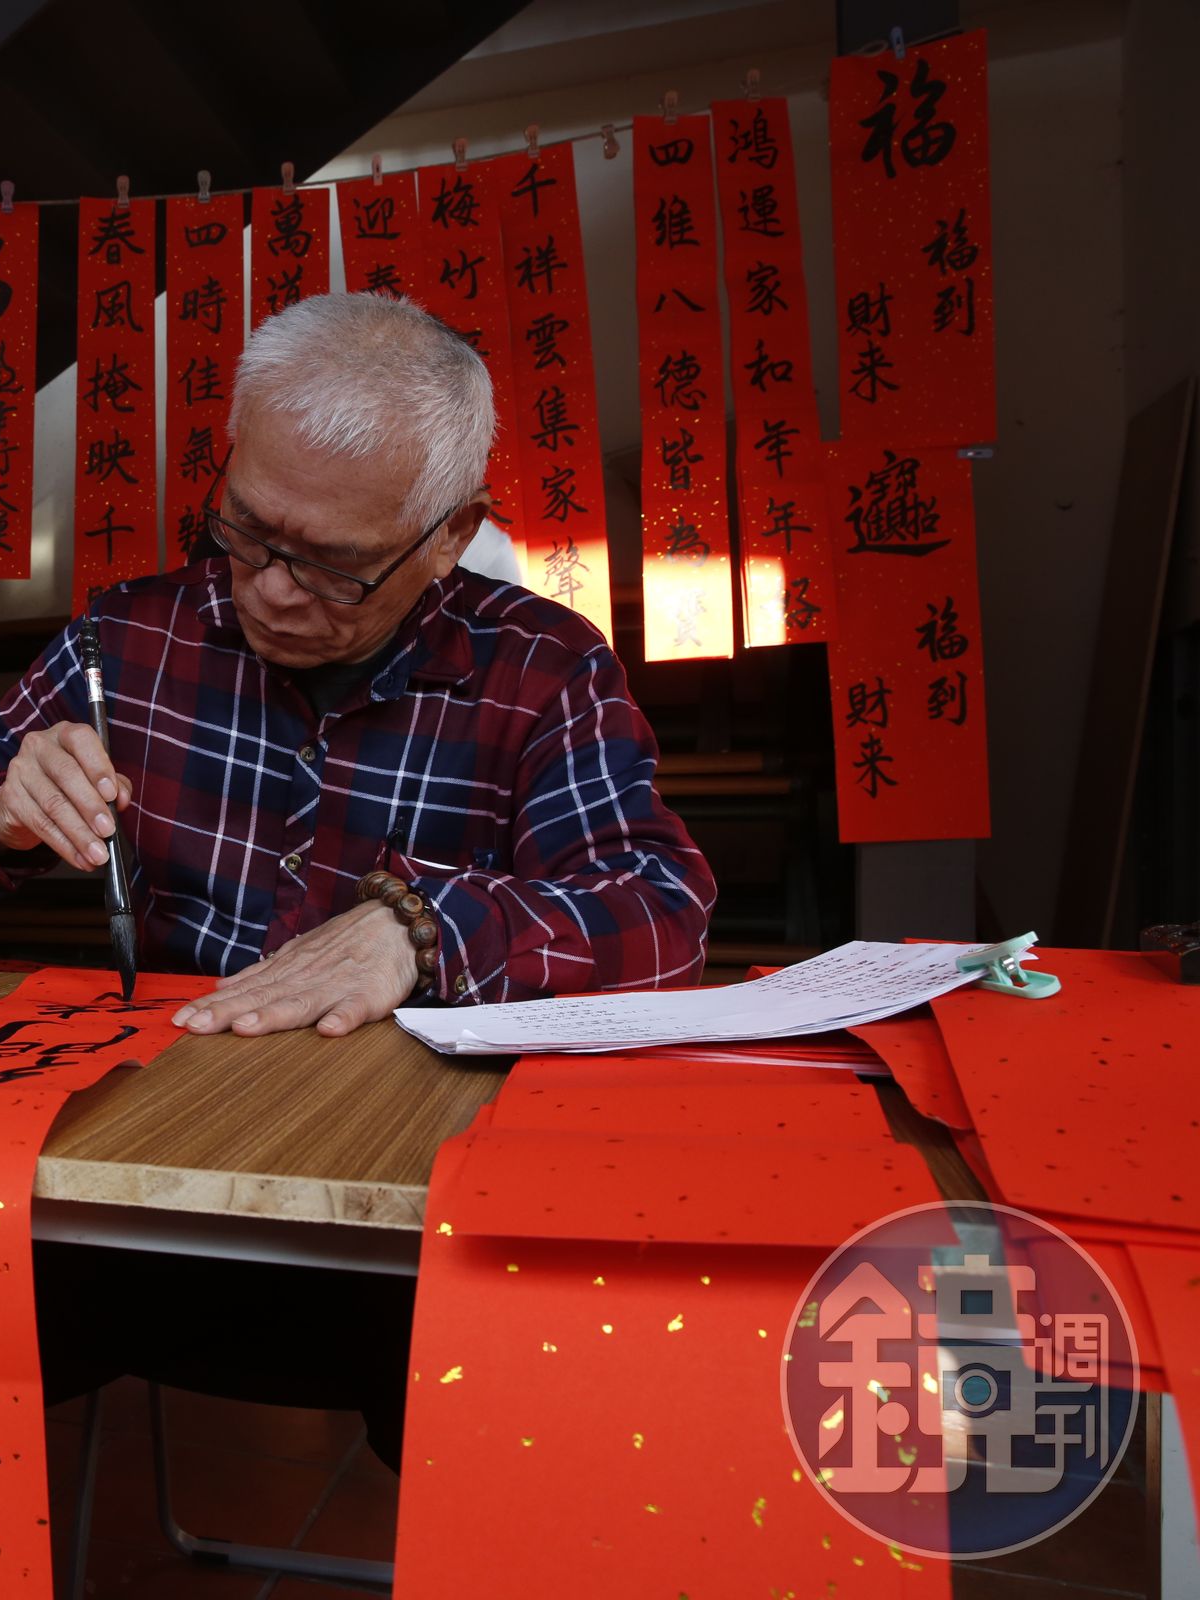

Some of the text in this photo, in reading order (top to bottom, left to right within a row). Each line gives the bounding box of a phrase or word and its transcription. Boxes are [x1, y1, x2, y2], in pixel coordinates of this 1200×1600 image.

[859, 58, 956, 179] 福
[921, 208, 978, 338] 福到
[82, 206, 145, 600] 春風掩映千
[510, 164, 590, 609] 千祥雲集家聲
[915, 596, 968, 727] 福到
